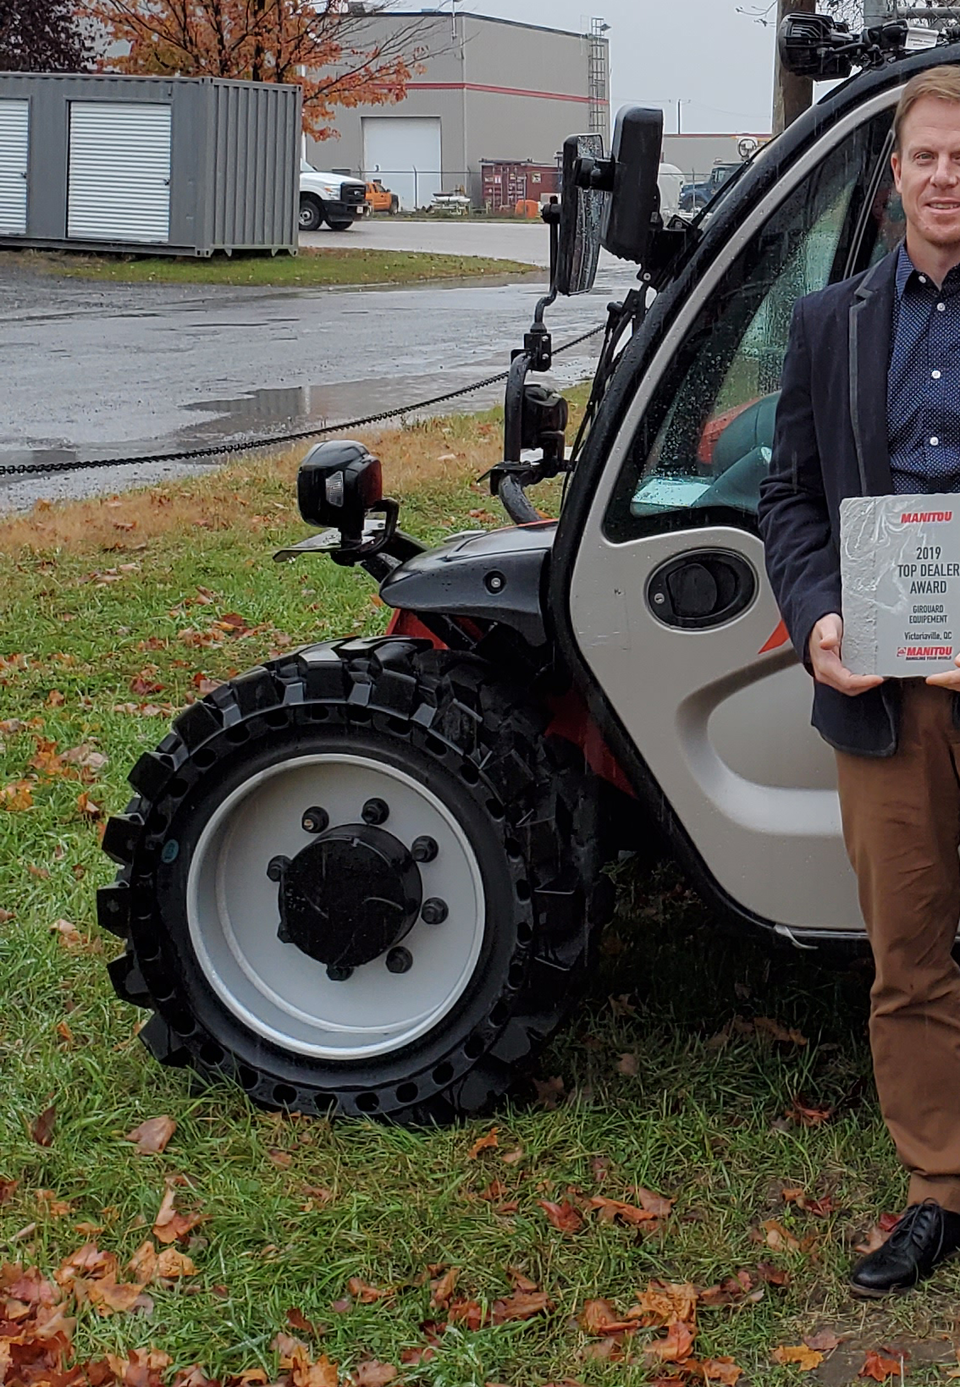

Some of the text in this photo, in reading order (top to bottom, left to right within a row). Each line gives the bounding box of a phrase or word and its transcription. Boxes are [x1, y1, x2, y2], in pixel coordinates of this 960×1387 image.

[901, 511, 952, 524] MANITOU
[916, 546, 942, 560] 2019
[897, 563, 960, 578] TOP DEALER
[910, 580, 947, 594] AWARD
[912, 604, 944, 613] GIROUARD
[909, 614, 948, 623] EQUIPEMENT
[904, 631, 952, 640] Victoriaville, QC
[907, 646, 952, 656] MANITOU
